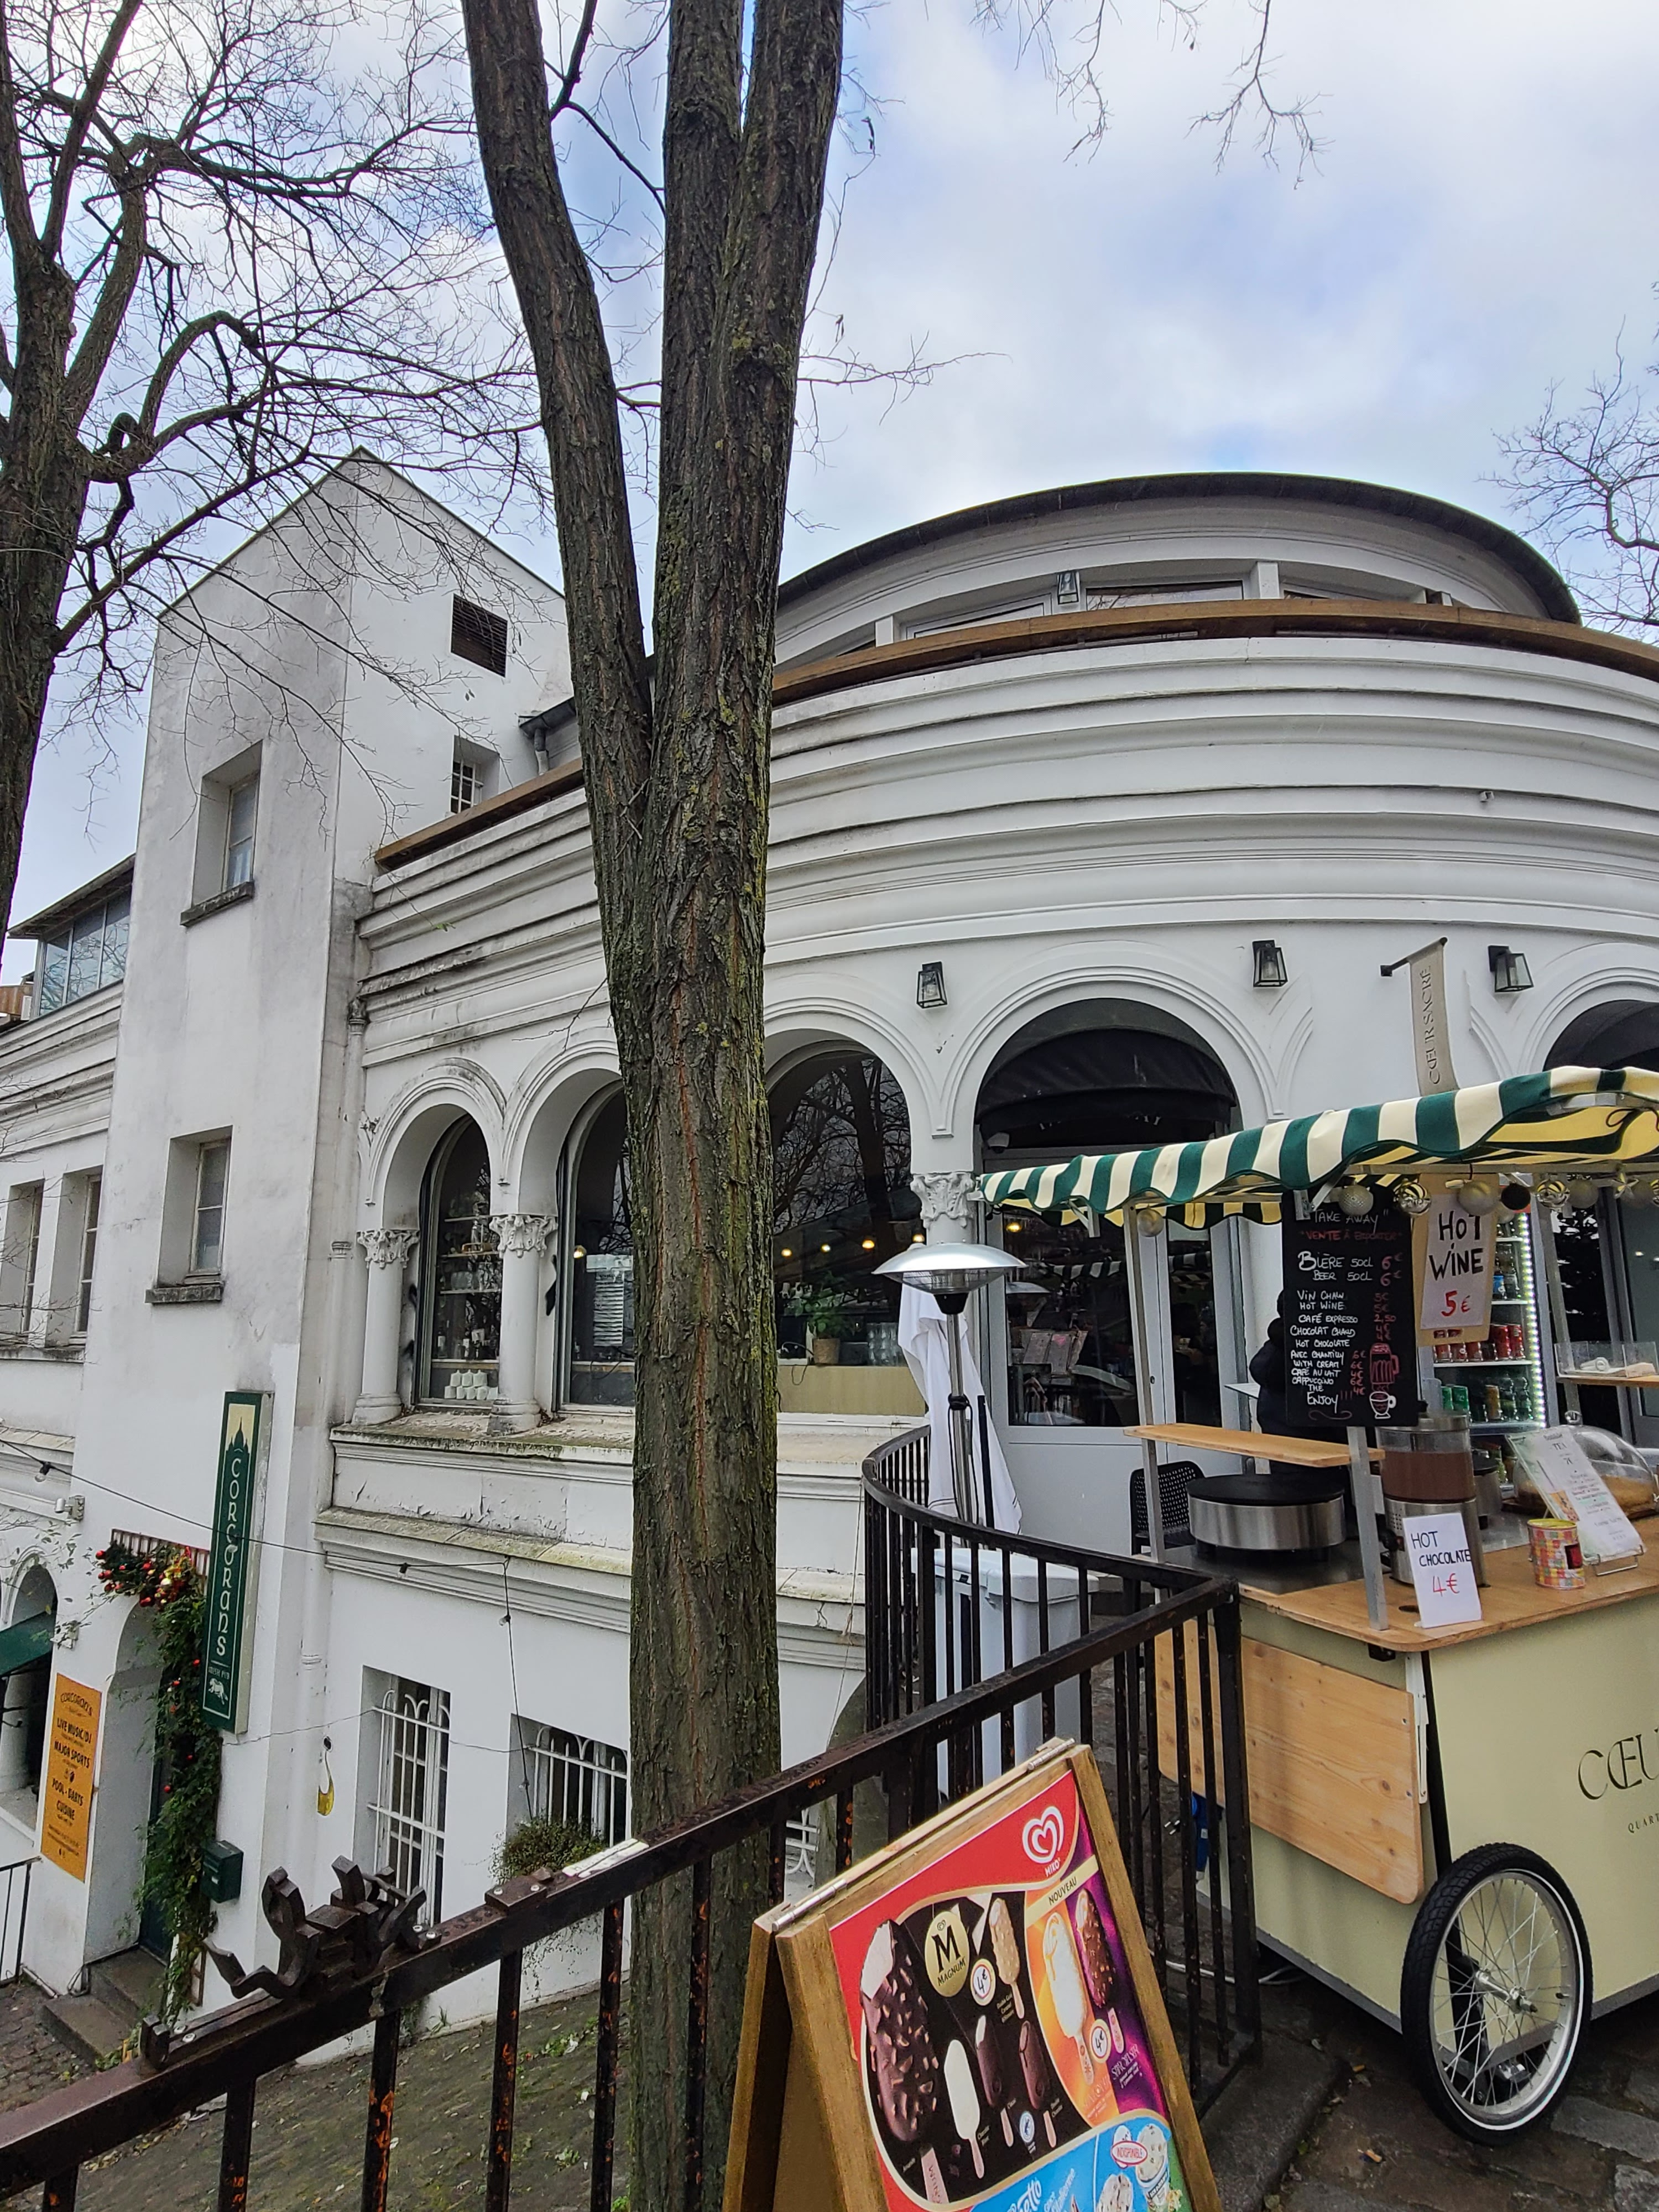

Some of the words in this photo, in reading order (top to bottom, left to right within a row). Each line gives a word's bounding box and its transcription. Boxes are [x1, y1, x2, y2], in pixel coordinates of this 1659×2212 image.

[1313, 1209, 1341, 1223] TAKE
[1438, 1211, 1480, 1240] HOT
[1298, 1251, 1345, 1271] BIÈRE
[1428, 1243, 1483, 1281] WINE
[1313, 1270, 1337, 1280] BEER
[1297, 1289, 1316, 1301] VIN
[1441, 1290, 1471, 1317] 5€
[1300, 1301, 1316, 1310] HOT
[1320, 1301, 1345, 1310] WINE
[1298, 1313, 1322, 1323] CAFÉ
[1326, 1315, 1358, 1325] EXPRESSO
[1290, 1325, 1328, 1337] CHOCOLAT
[1314, 1339, 1350, 1348] CHOCOLATE
[1291, 1350, 1308, 1359] AVEC
[1291, 1367, 1310, 1376] CAFÉ
[1308, 1383, 1324, 1392] THÉ
[1307, 1391, 1338, 1414] ENJOY
[1410, 1530, 1438, 1549] HOT
[1419, 1548, 1472, 1567] CHOCOLATE
[1432, 1573, 1460, 1597] 4€
[57, 1717, 67, 1731] LIVE
[71, 1749, 90, 1768] SPORTS
[1048, 1876, 1077, 1906] NOUVEAU
[931, 1924, 961, 1973] M
[937, 1956, 966, 1986] MAGNUM
